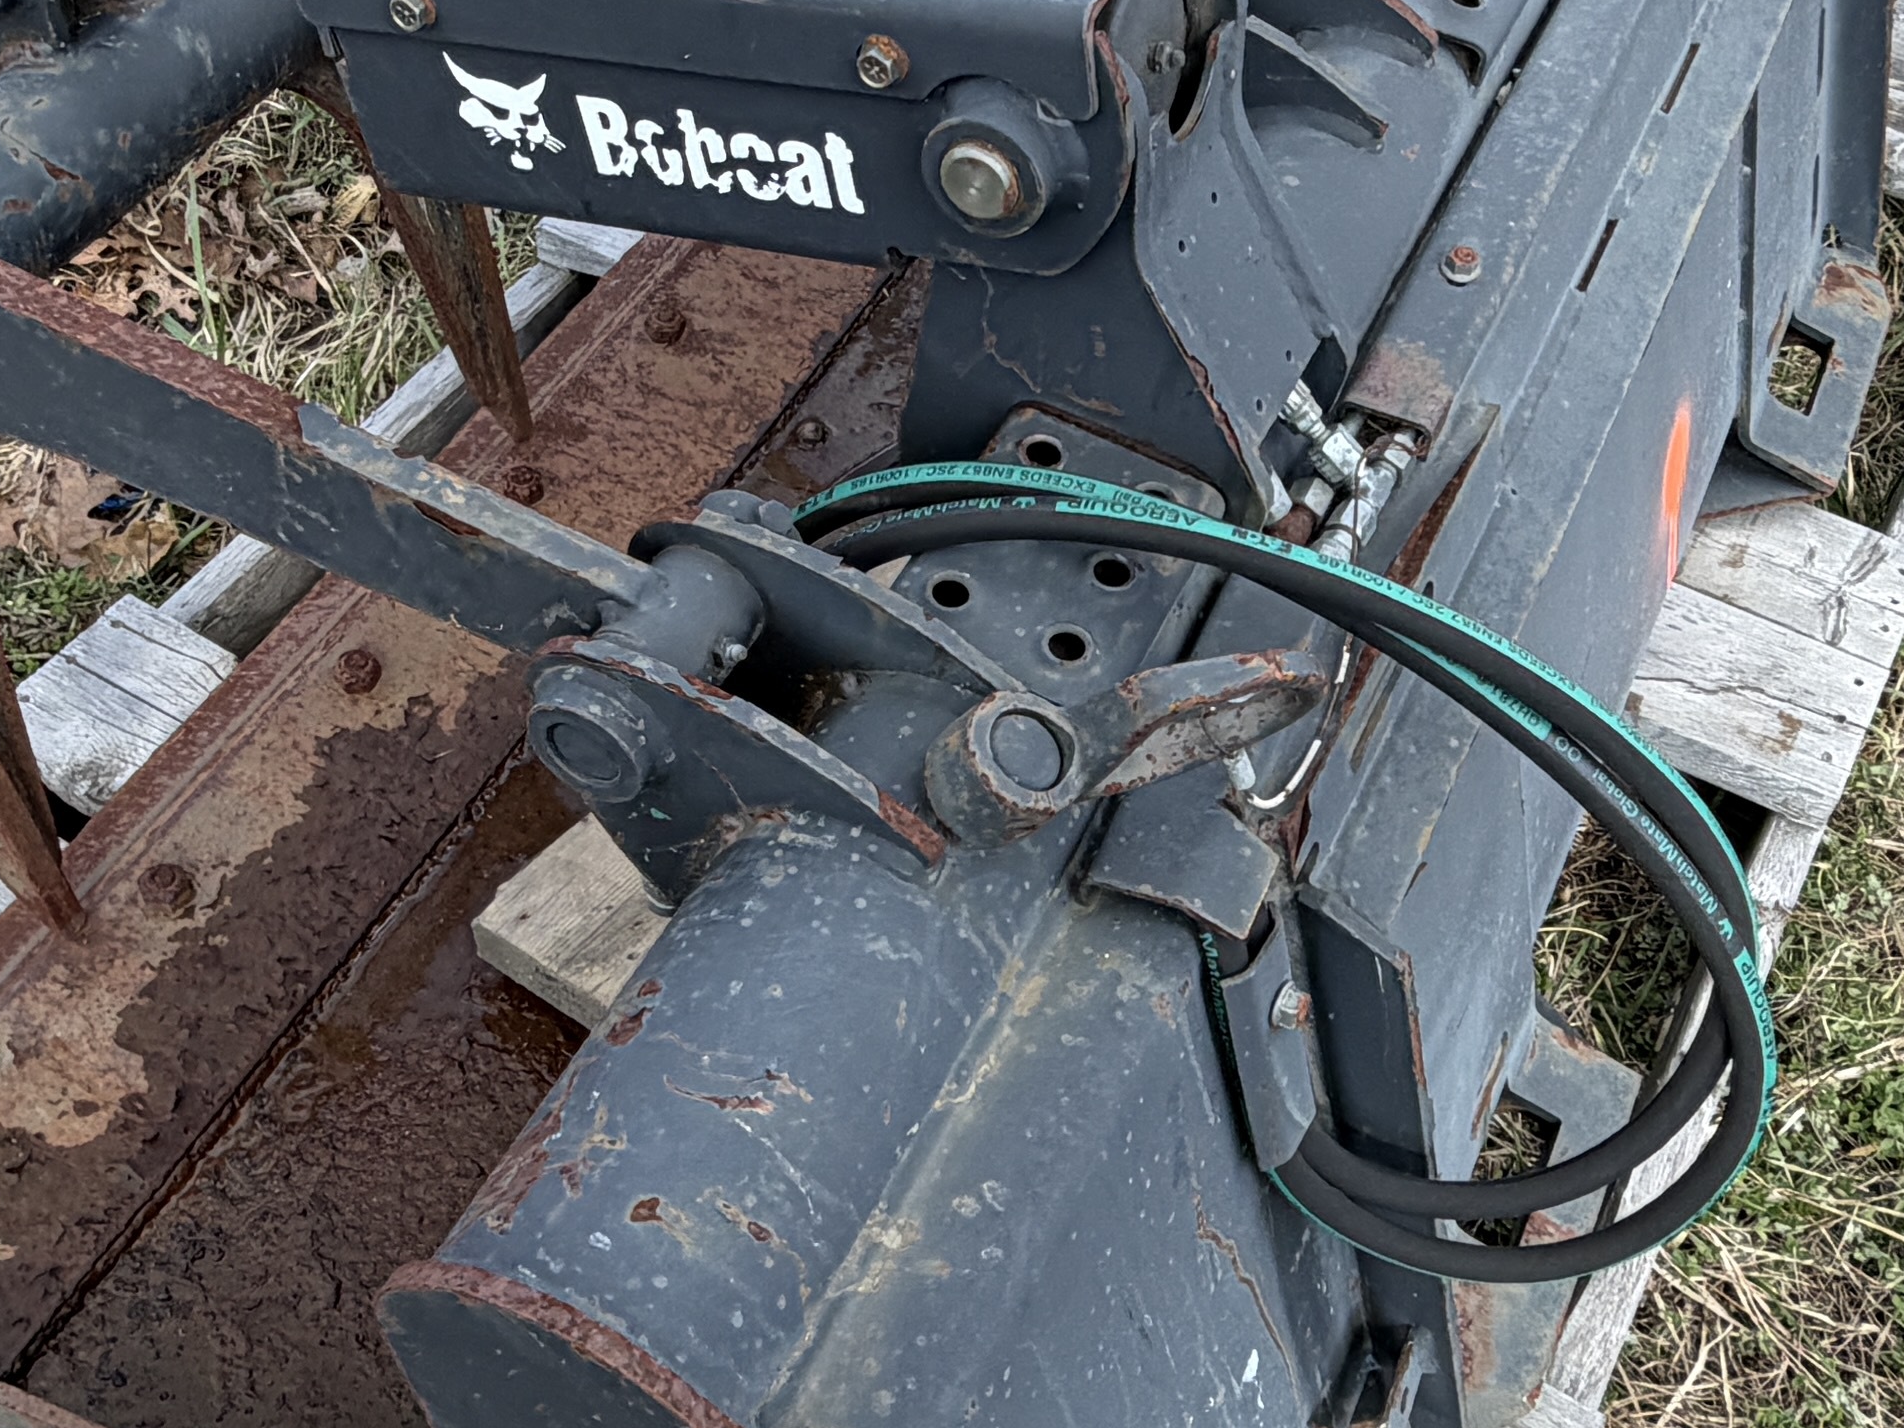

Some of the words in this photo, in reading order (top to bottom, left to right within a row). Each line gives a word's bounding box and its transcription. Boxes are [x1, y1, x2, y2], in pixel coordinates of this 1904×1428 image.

[575, 94, 865, 214] Bobcat
[926, 465, 955, 476] 2SC
[1020, 470, 1096, 493] EXCEEDS
[1067, 497, 1201, 526] AEROQUIP
[1592, 768, 1640, 818] Global
[1741, 961, 1776, 1060] AEROQUIP
